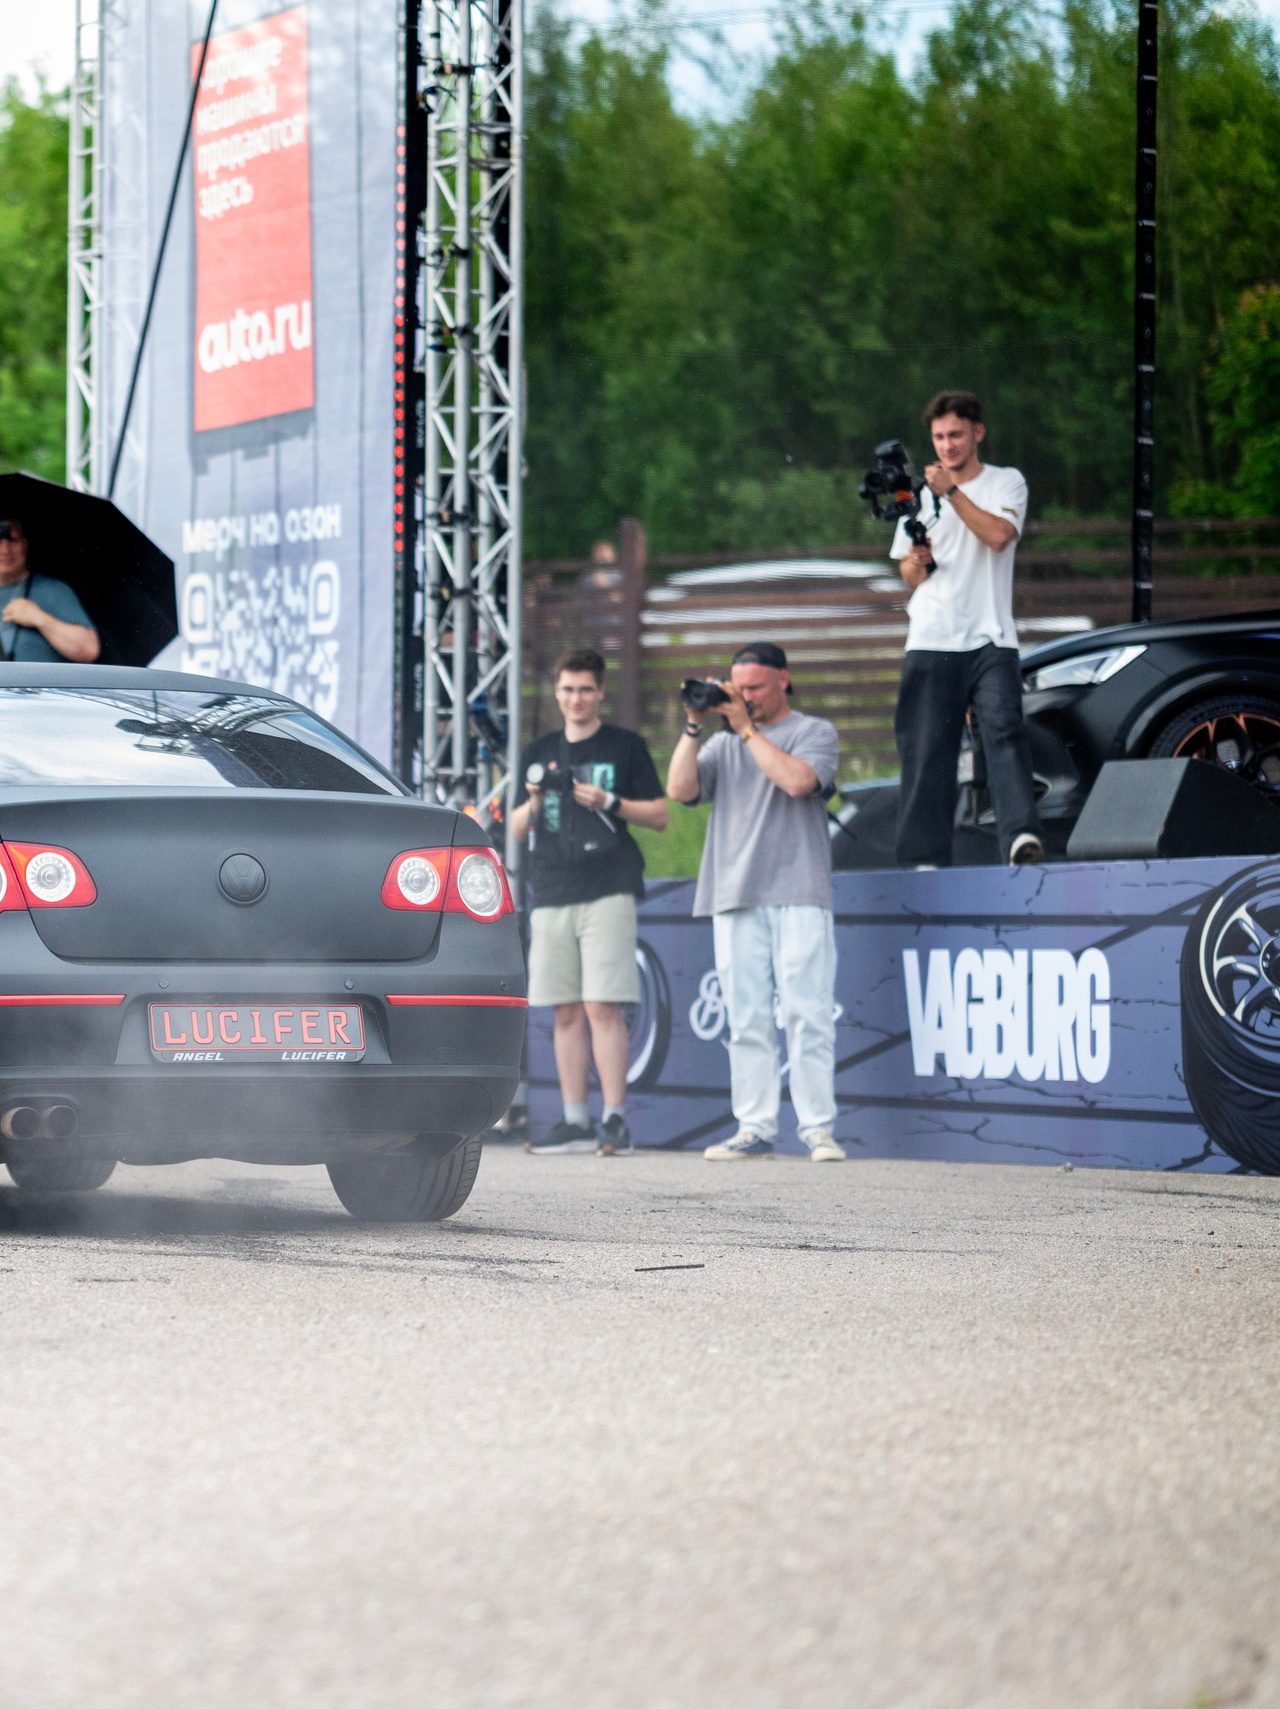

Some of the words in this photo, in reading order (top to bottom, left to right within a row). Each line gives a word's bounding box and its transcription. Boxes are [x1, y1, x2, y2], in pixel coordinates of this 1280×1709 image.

[198, 113, 305, 181] продаются
[199, 176, 254, 221] здесь
[198, 300, 311, 373] auto.ru
[162, 1010, 352, 1045] LUCIFER
[902, 947, 1110, 1084] VAGBURG
[173, 1052, 224, 1061] ANGEL
[281, 1051, 347, 1061] LUCIFER
